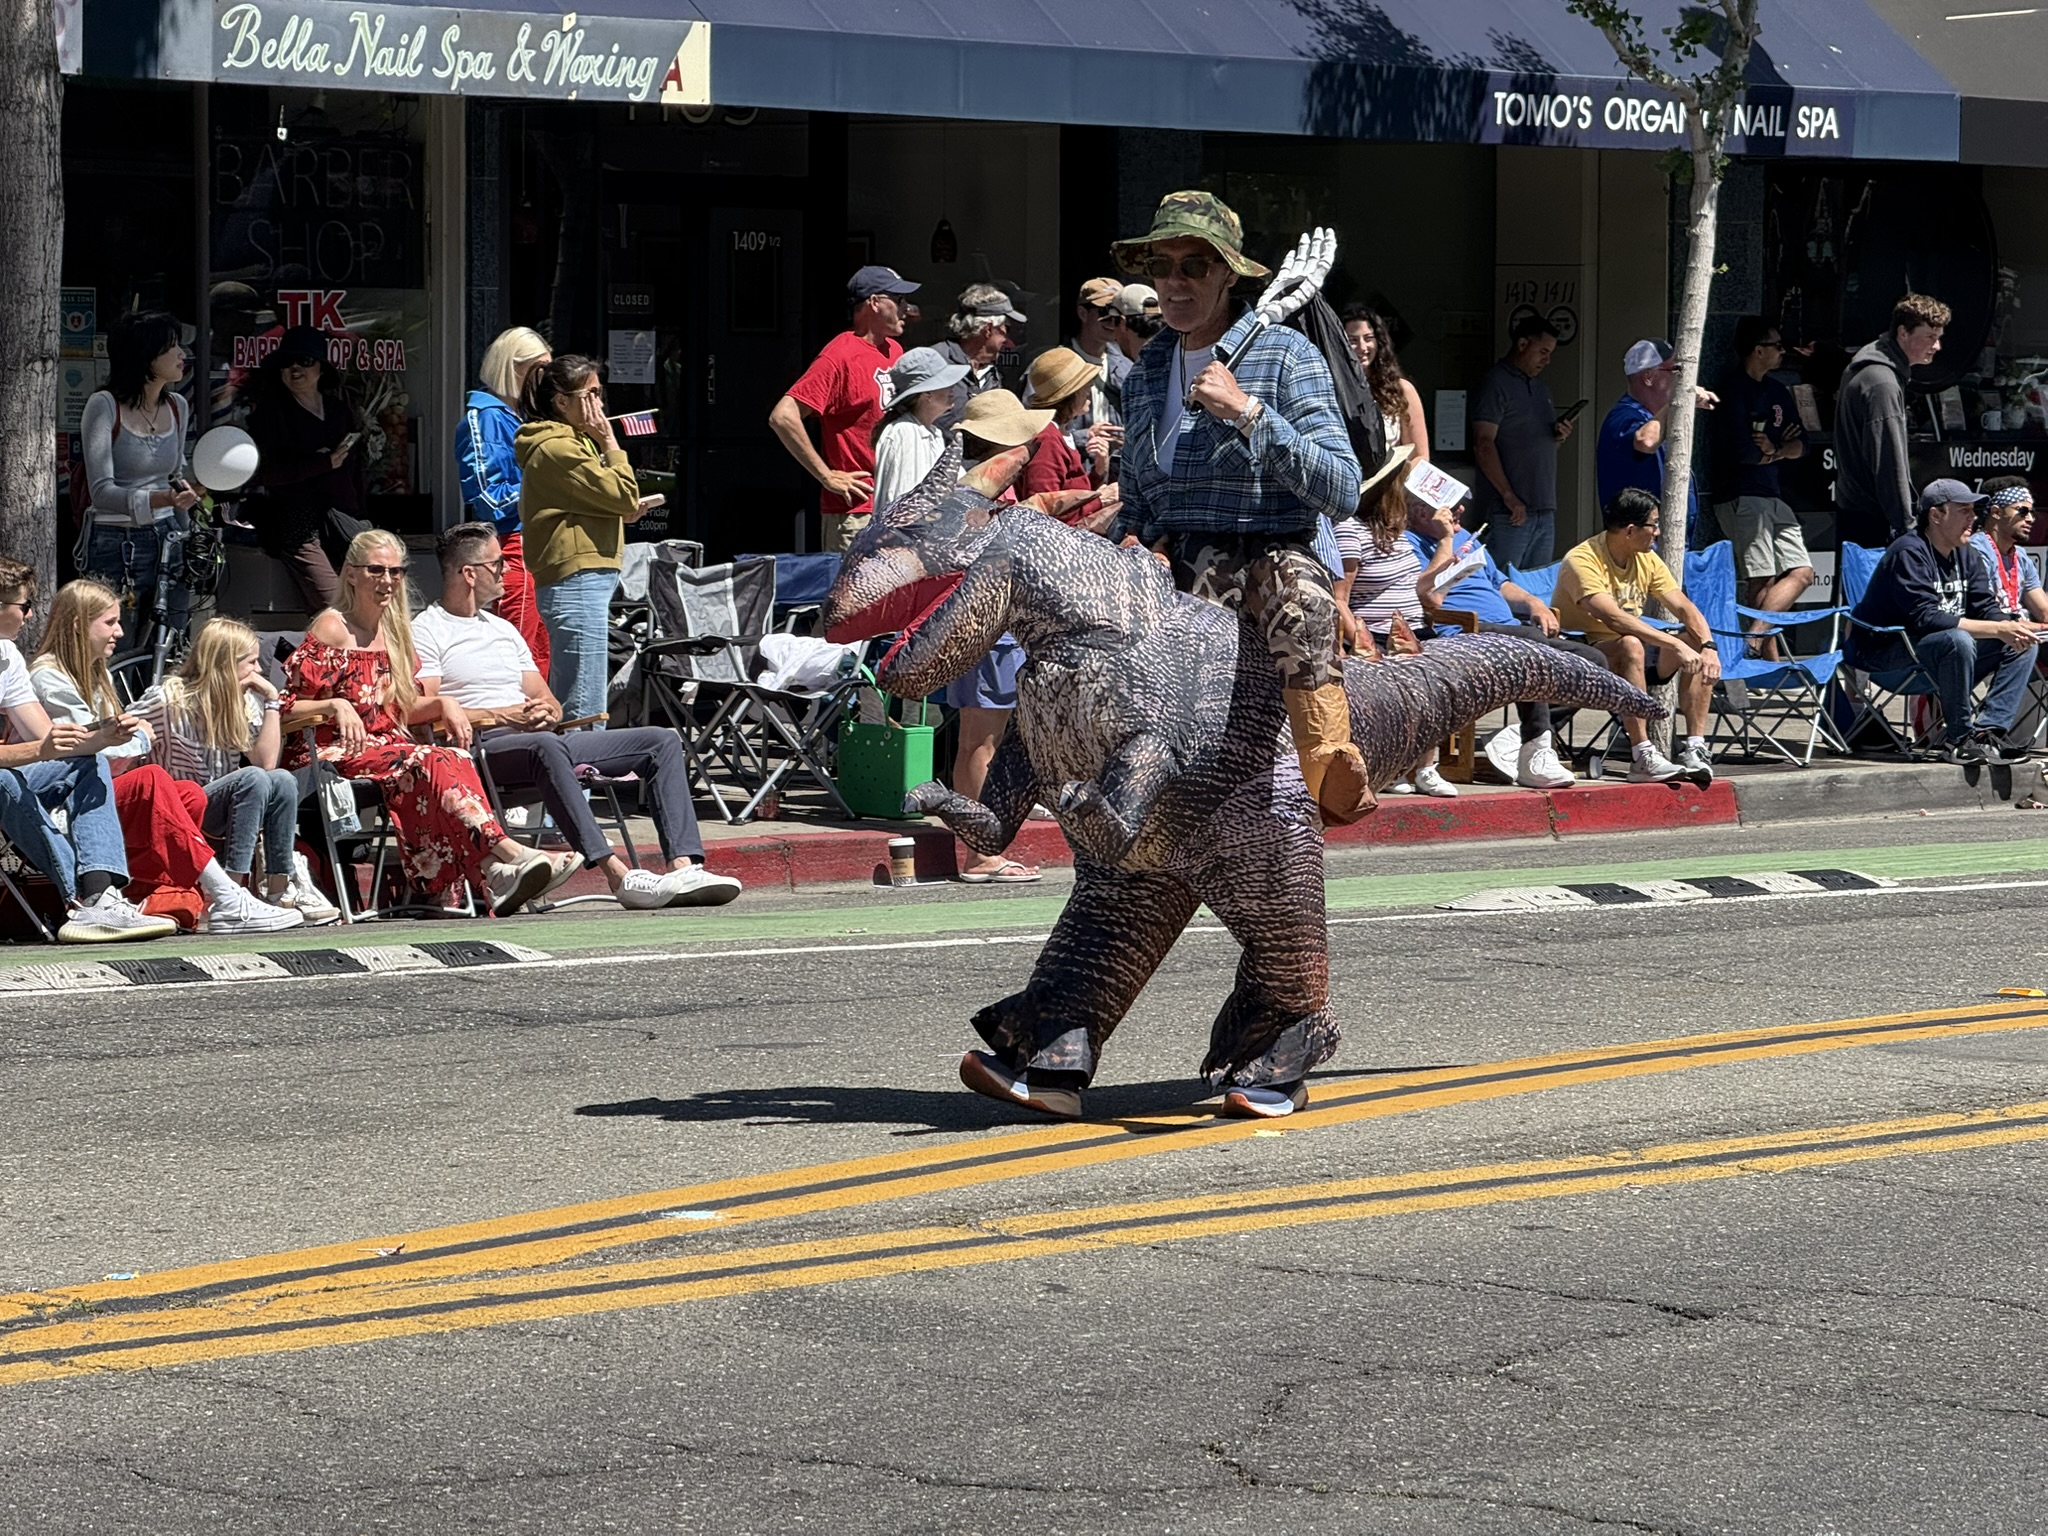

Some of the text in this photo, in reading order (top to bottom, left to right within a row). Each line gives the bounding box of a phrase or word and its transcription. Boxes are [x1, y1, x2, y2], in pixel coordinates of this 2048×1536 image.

[221, 3, 658, 102] Bella Nail Spa & Waxing
[1494, 91, 1592, 130] TOMO'S
[1734, 104, 1786, 137] NAIL
[1797, 106, 1840, 139] SPA
[216, 143, 414, 210] BARBER
[249, 219, 385, 283] SHOP
[733, 231, 766, 251] 1409
[613, 294, 650, 306] CLOSED
[1544, 281, 1576, 304] 1411
[277, 289, 347, 332] TK
[356, 338, 370, 371] &
[373, 339, 406, 371] SPA
[1949, 446, 2035, 472] Wednesday
[638, 520, 668, 532] 5:00pm
